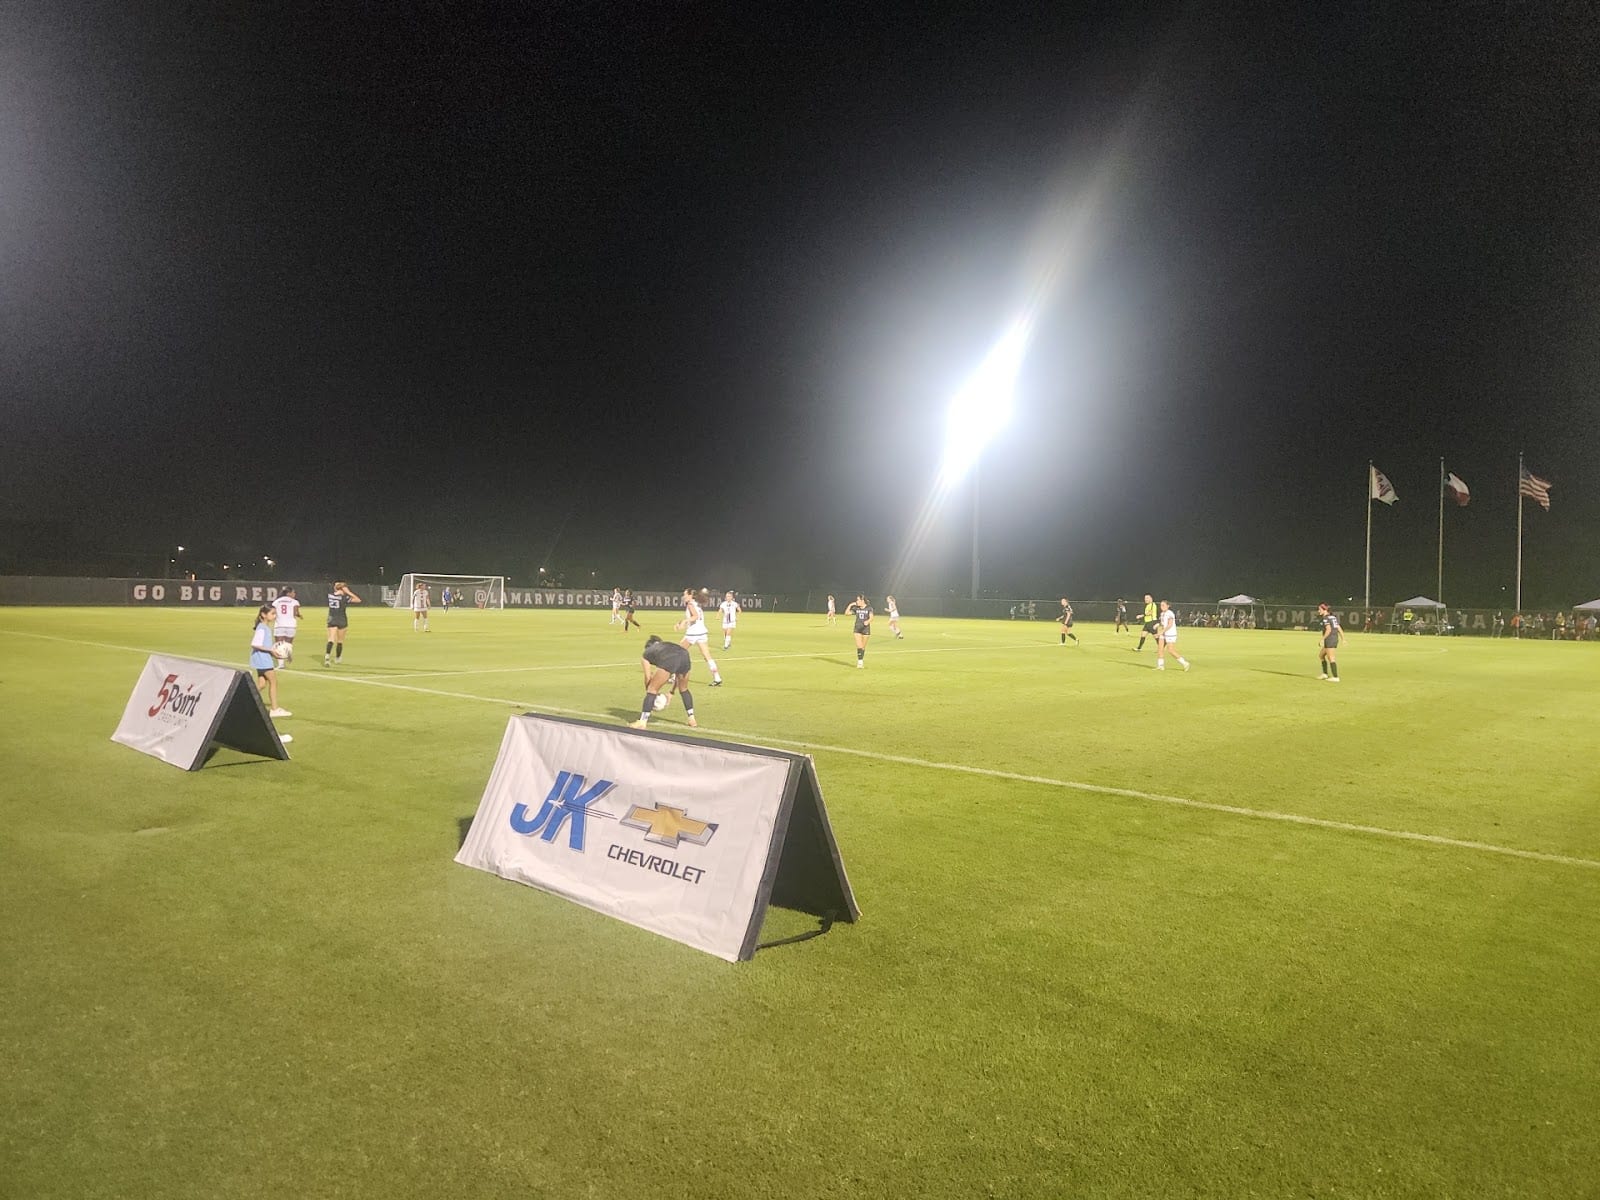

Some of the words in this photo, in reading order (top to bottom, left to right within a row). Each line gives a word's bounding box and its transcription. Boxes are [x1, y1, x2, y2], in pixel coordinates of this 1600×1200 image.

[133, 584, 165, 601] GO
[180, 585, 221, 601] BIG
[280, 604, 287, 614] 8
[510, 770, 617, 853] JK
[607, 844, 706, 885] CHEVROLET
